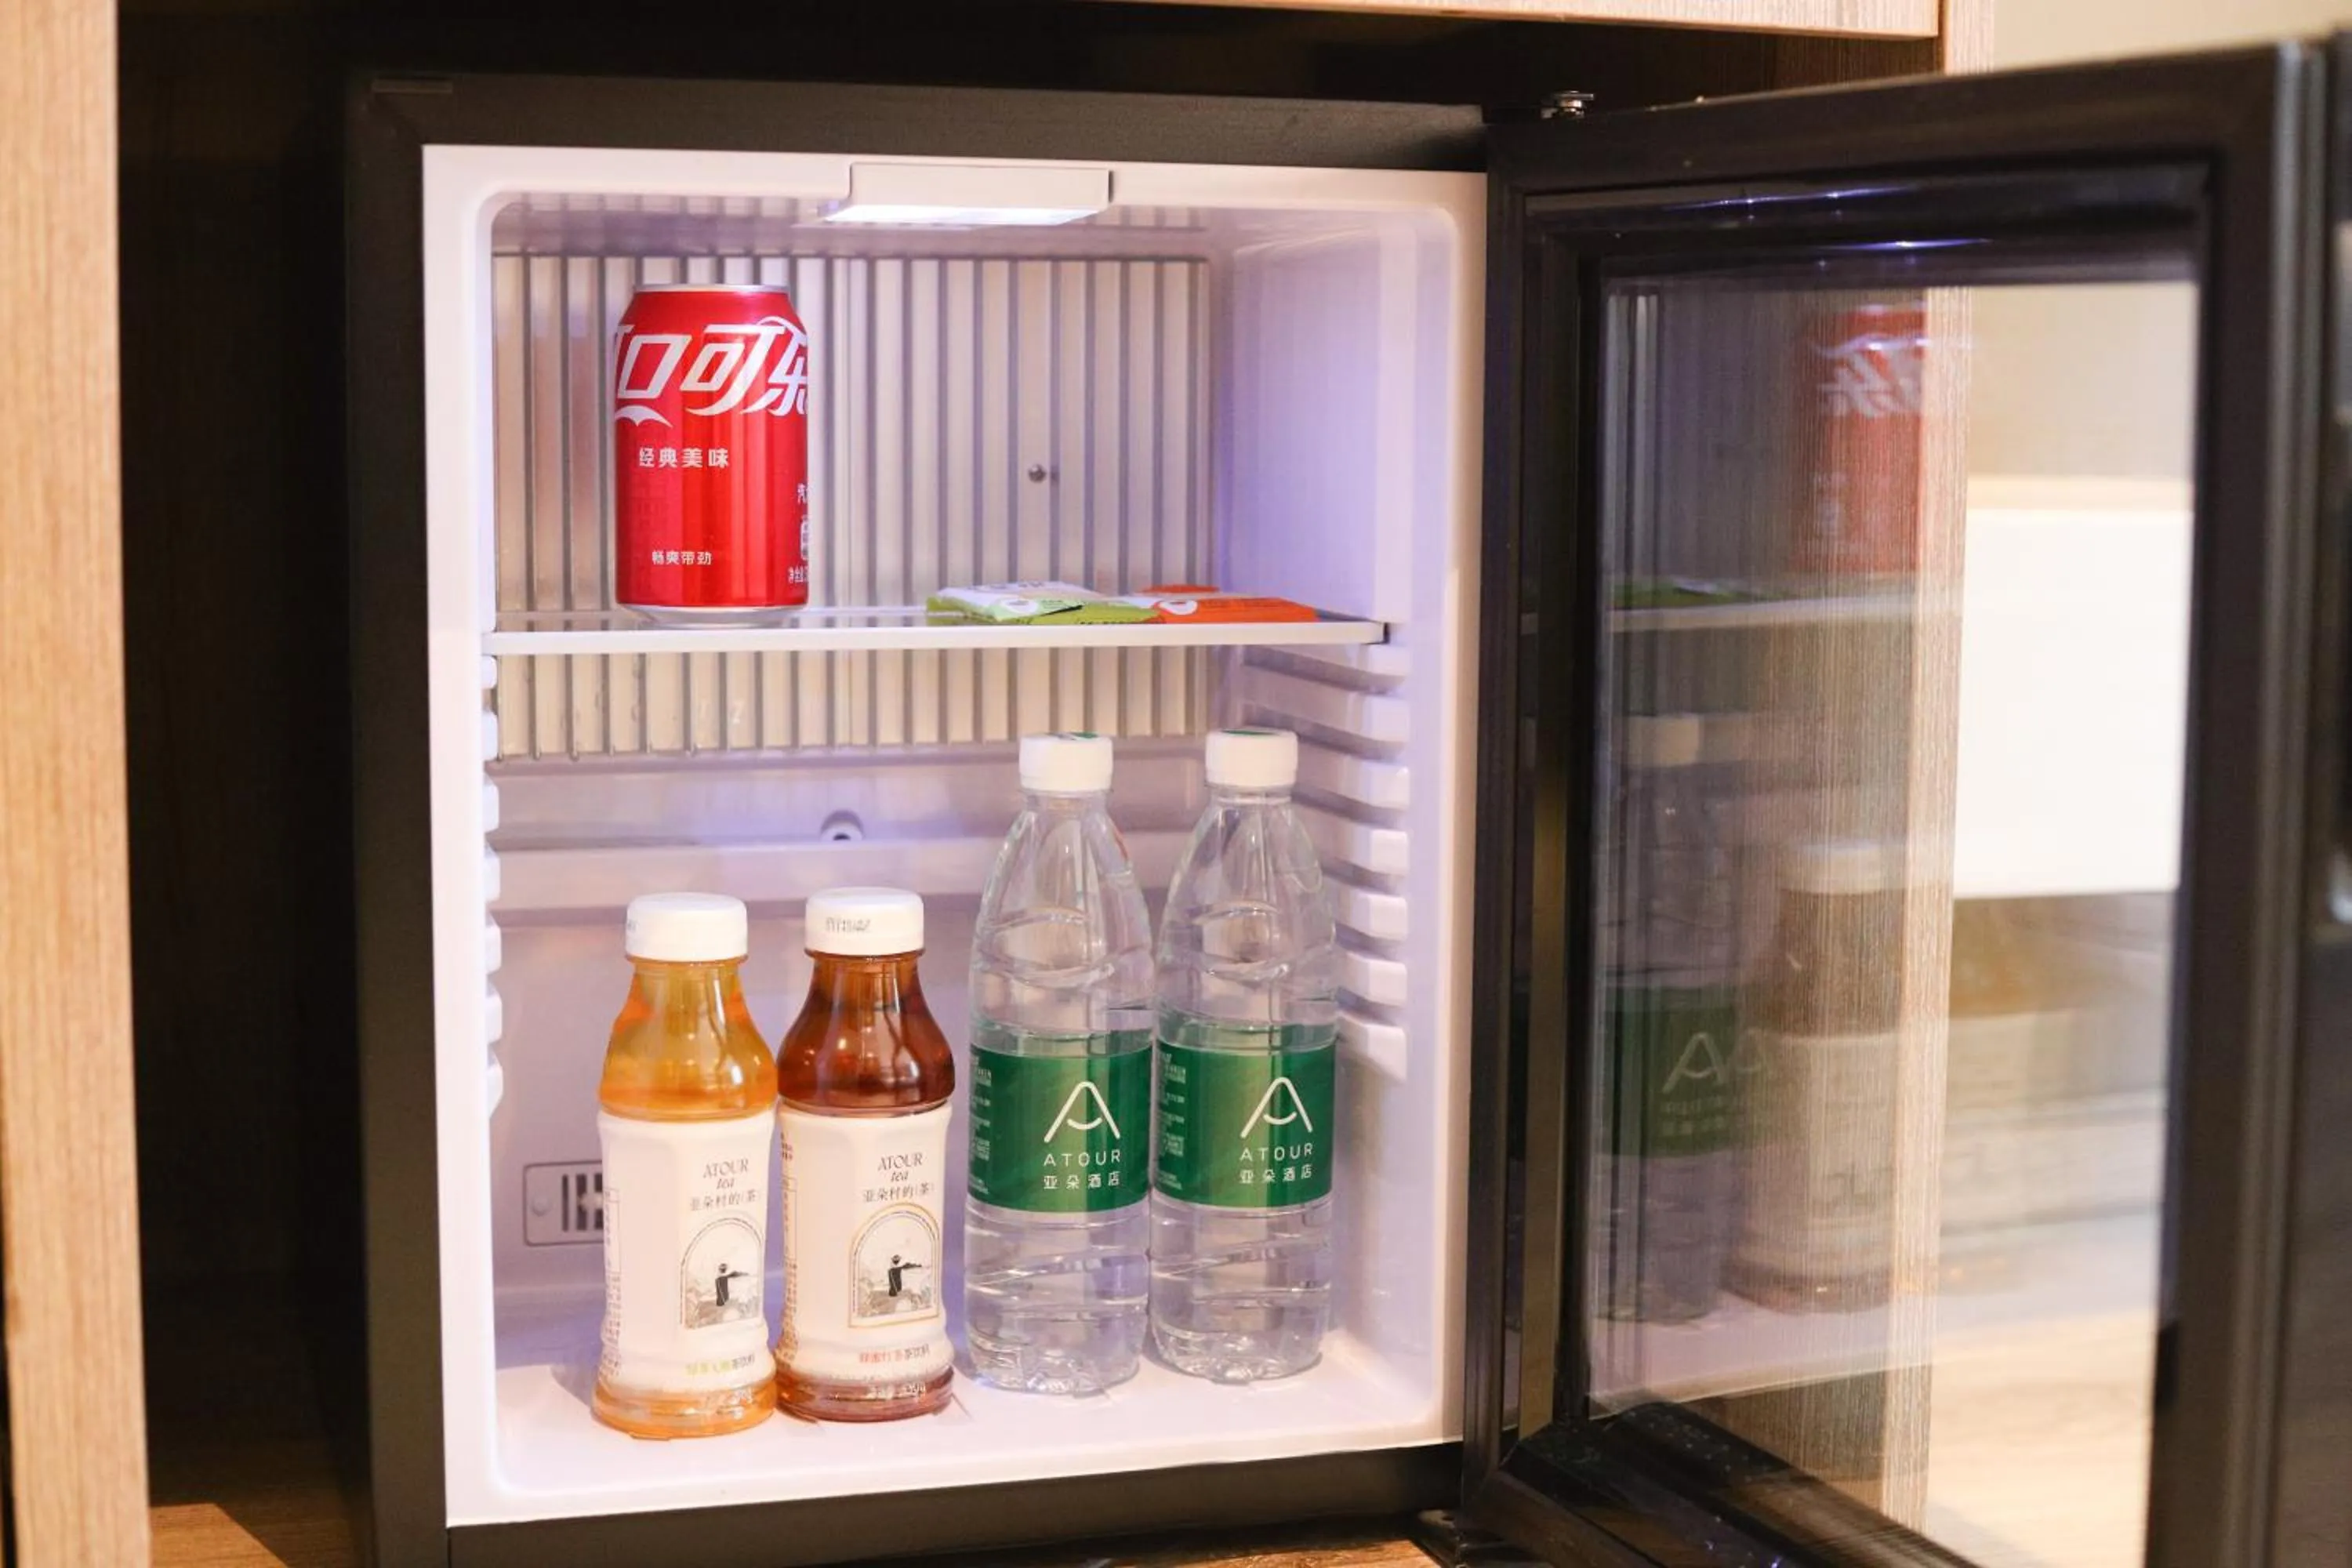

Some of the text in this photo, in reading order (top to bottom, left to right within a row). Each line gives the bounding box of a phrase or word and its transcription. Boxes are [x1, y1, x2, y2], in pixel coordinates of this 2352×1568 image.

[615, 316, 808, 416] 口可乐
[639, 447, 729, 468] 经典美味
[652, 550, 713, 565] 畅爽带劲
[877, 1152, 924, 1171] ATOUR
[1043, 1149, 1121, 1167] ATOUR
[1240, 1142, 1314, 1162] ATOUR
[702, 1158, 749, 1178] ATOUR
[1239, 1163, 1313, 1184] 亚朵酒店
[1043, 1171, 1121, 1189] 亚朵酒店
